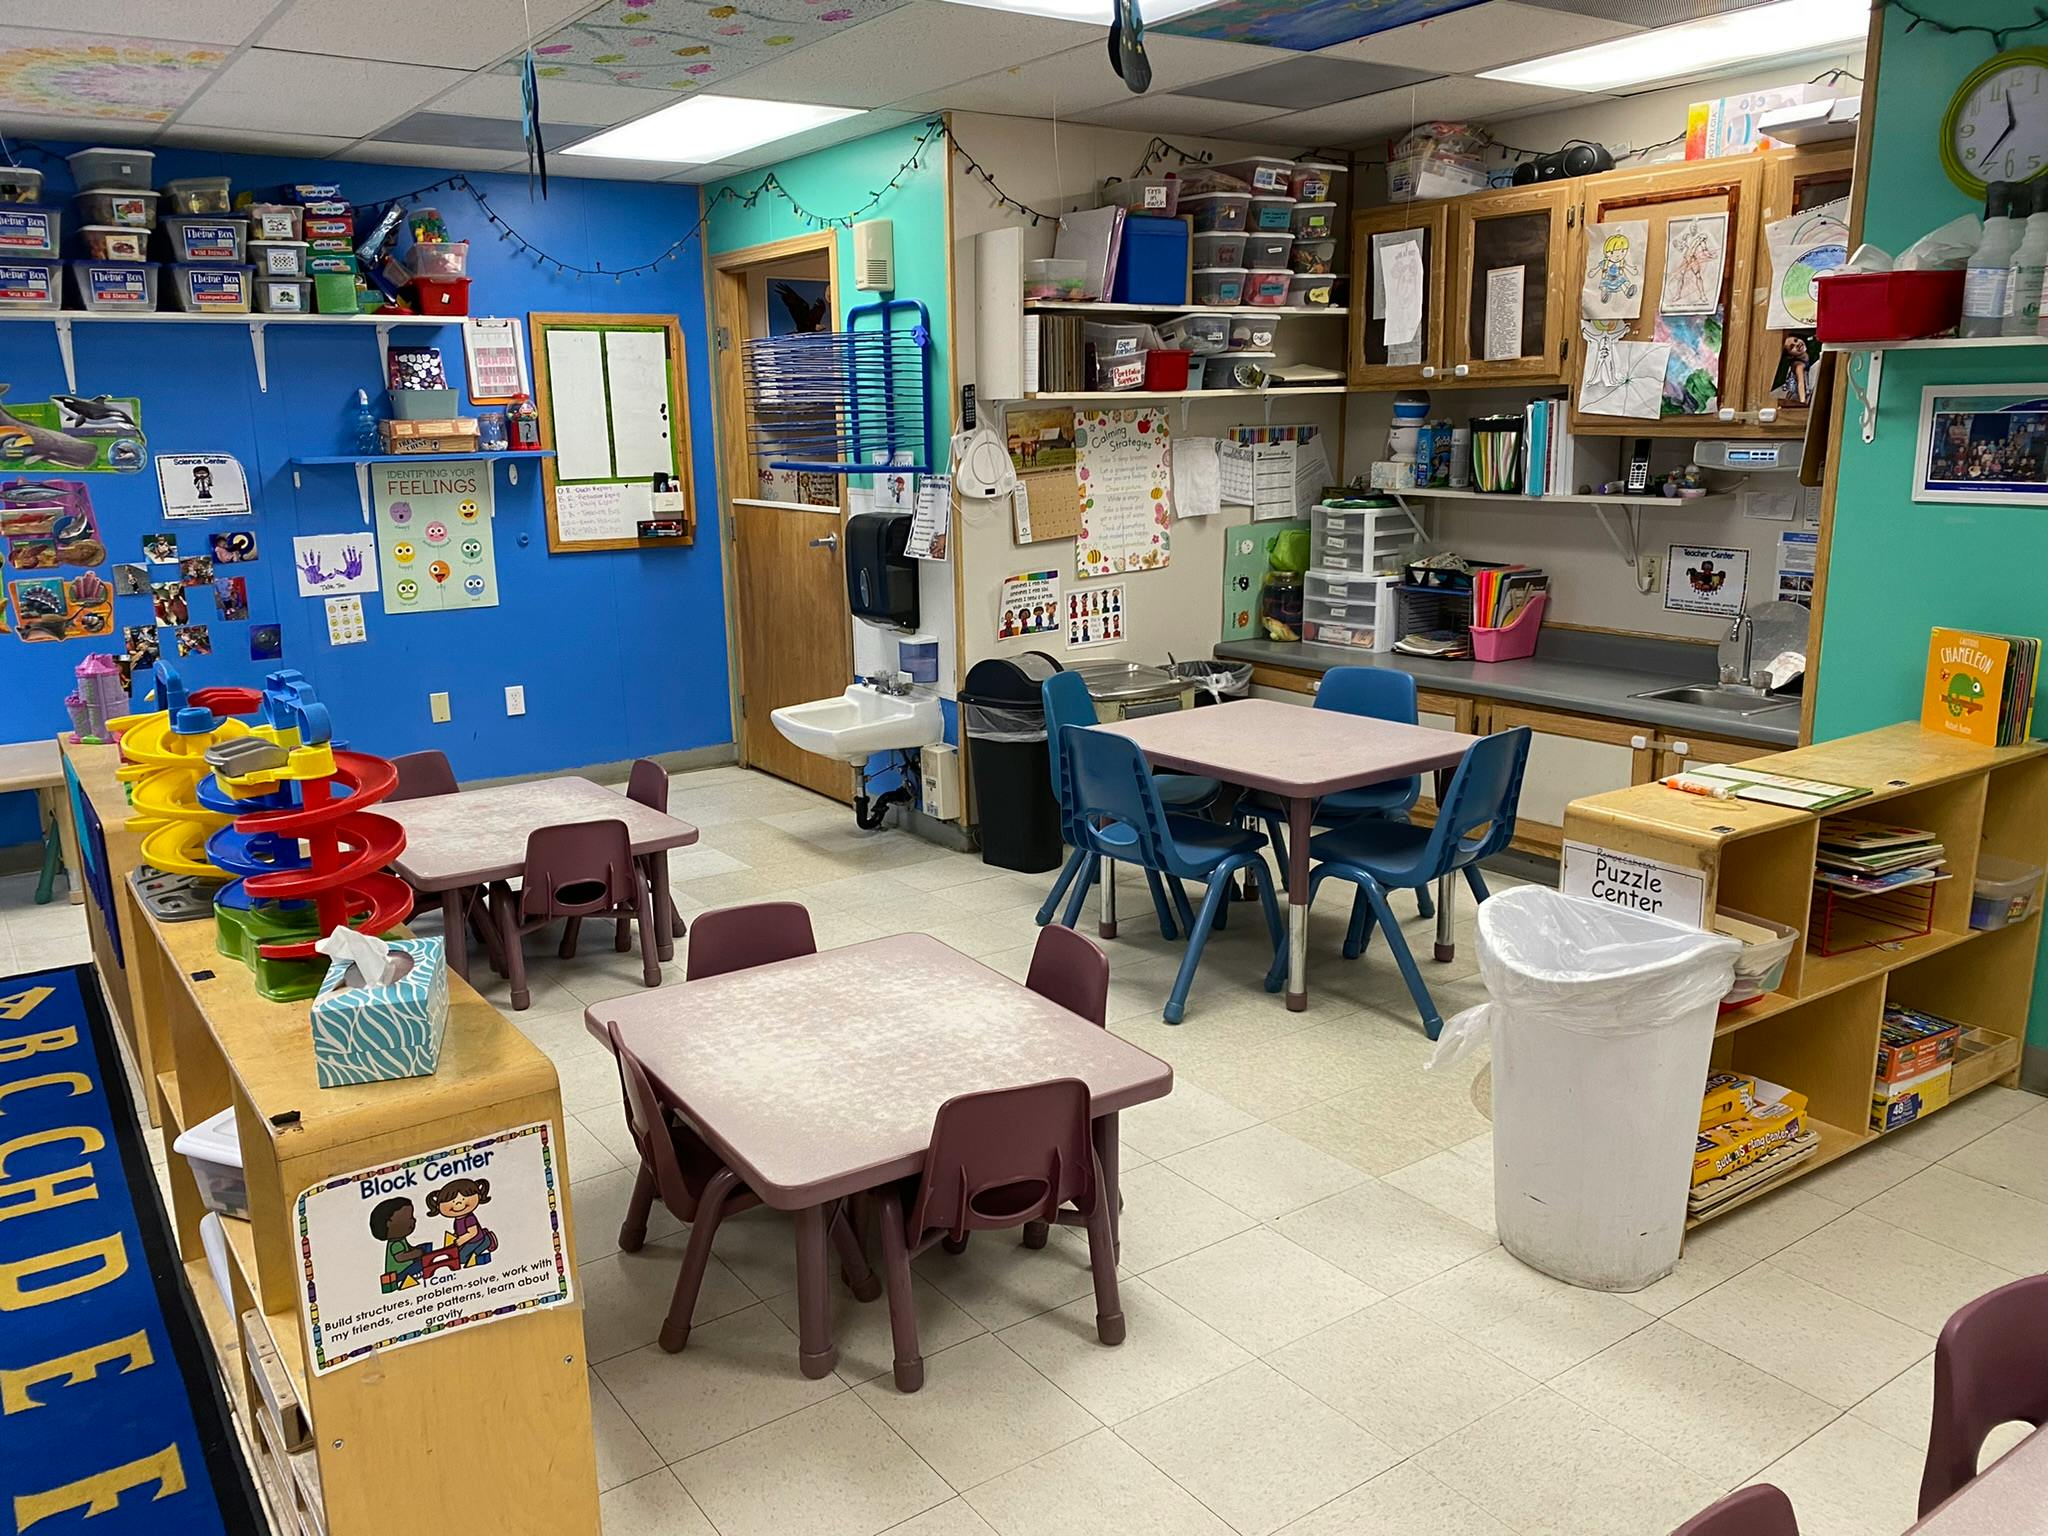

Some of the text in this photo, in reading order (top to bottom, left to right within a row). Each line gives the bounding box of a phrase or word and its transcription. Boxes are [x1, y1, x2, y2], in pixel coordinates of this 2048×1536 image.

[2009, 70, 2024, 88] 12
[2032, 73, 2040, 95] 1
[1990, 80, 2001, 102] 11
[1967, 96, 1980, 117] 10
[1708, 111, 1718, 159] OSTALGIA
[1960, 124, 1976, 139] 9
[1965, 147, 1977, 160] 8
[2026, 155, 2041, 170] 5
[1982, 161, 1999, 175] 7
[2004, 148, 2016, 178] 6
[186, 229, 234, 239] Theme Box
[29, 270, 47, 280] Box
[93, 272, 143, 282] Theme Box
[192, 273, 239, 284] Theme Box
[1114, 367, 1141, 380] Portfolio
[1091, 427, 1127, 449] Calming
[1109, 437, 1152, 452] Strategies
[387, 468, 476, 479] IDENTIFYING YOUR
[388, 478, 477, 496] FEELINGS
[1684, 548, 1735, 560] Teacher Center
[1940, 646, 1994, 675] CHAMELEON
[1596, 858, 1662, 893] Puzzle
[1592, 880, 1663, 913] Center
[1893, 1102, 1904, 1115] 48
[1739, 1138, 1766, 1157] Sorting
[1765, 1130, 1789, 1144] Center
[360, 1151, 495, 1200] Block Center
[0, 1231, 129, 1313] D
[430, 1272, 457, 1286] Can:
[324, 1258, 553, 1332] Build structures, problem-solve, work with
[331, 1271, 551, 1343] my friends, create patterns, learn about
[425, 1308, 464, 1327] gravity
[0, 1329, 156, 1416] E
